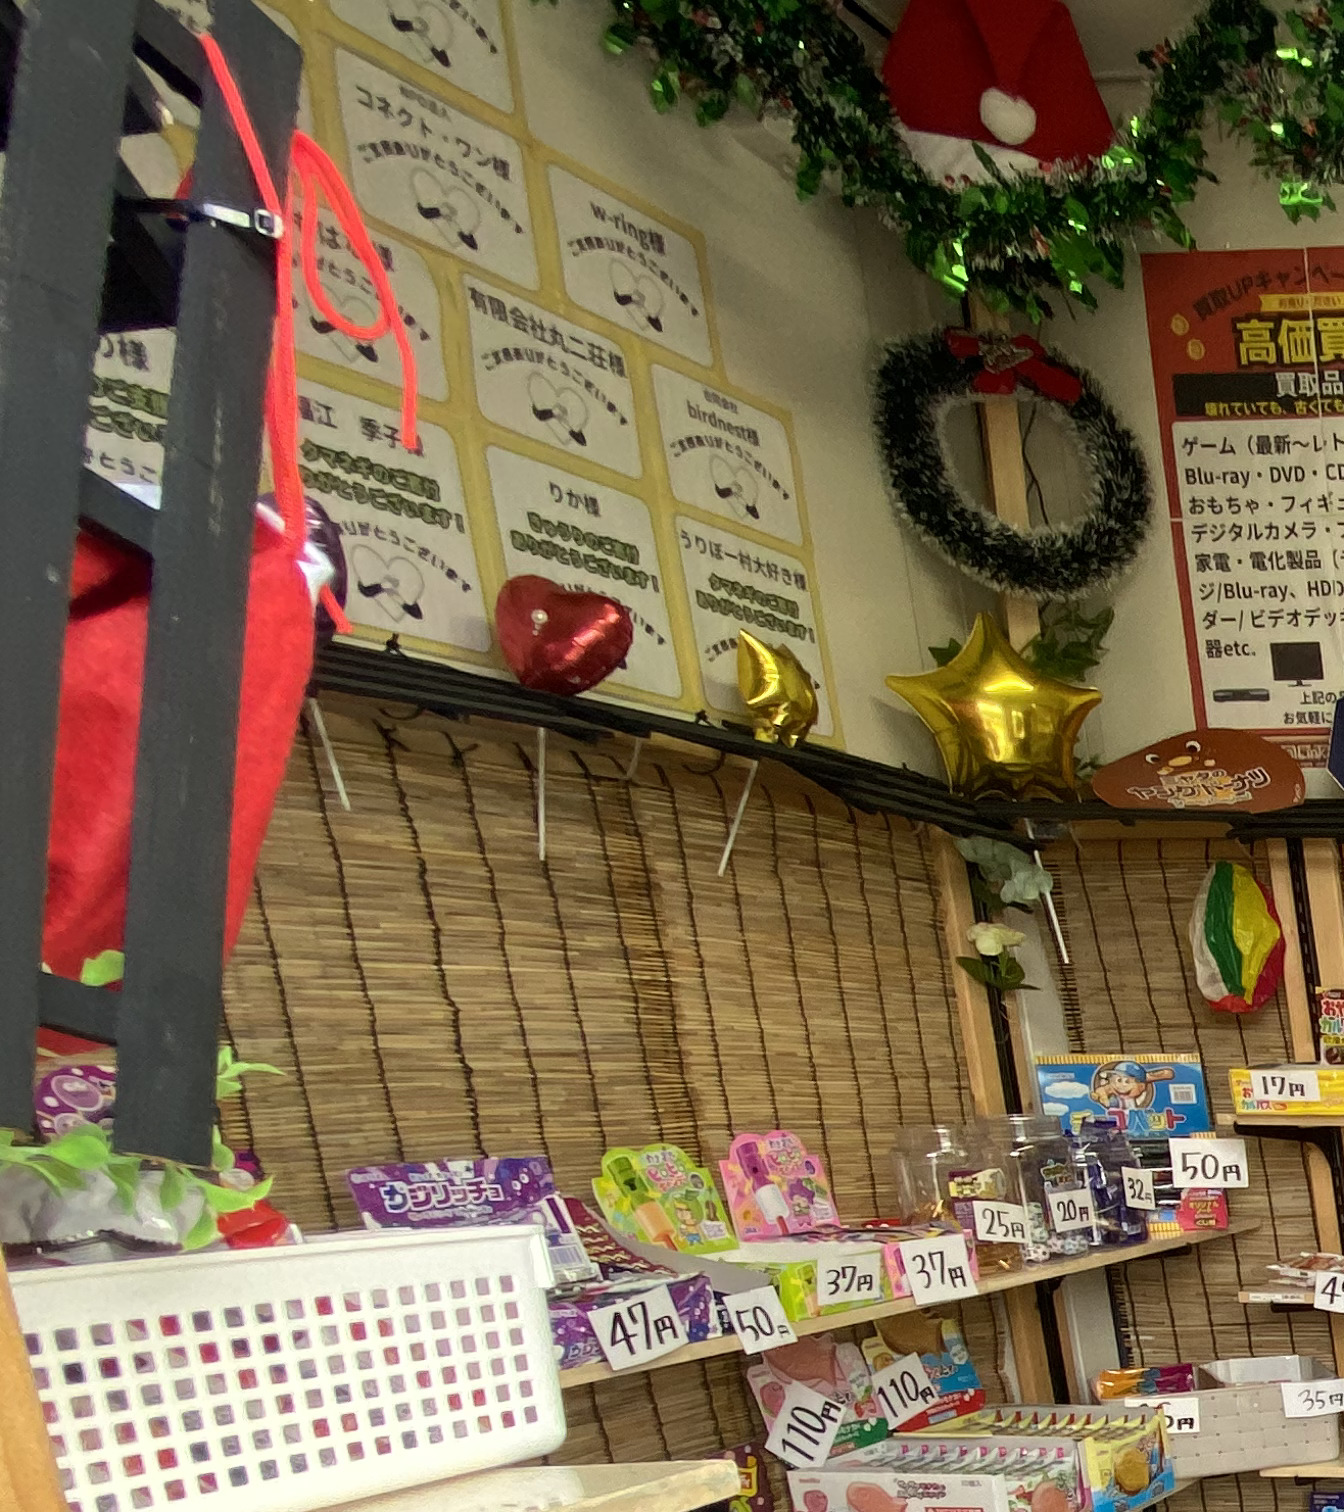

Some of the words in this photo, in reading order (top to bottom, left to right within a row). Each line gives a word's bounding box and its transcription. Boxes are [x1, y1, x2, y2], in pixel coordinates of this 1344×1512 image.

[590, 202, 666, 255] w-ring様
[686, 400, 760, 447] birdnest様
[1205, 639, 1257, 659] 器etc.
[1261, 1075, 1305, 1098] 17円
[1180, 1151, 1242, 1183] 50円
[1127, 1177, 1153, 1203] 32円
[982, 1208, 1025, 1239] 25円
[1056, 1199, 1090, 1224] 20円
[826, 1264, 874, 1296] 37円
[911, 1250, 968, 1289] 37円
[610, 1300, 681, 1357] 47円
[735, 1305, 790, 1343] 50円
[876, 1370, 936, 1418] 110円
[1300, 1389, 1344, 1412] 35円
[781, 1400, 843, 1462] 110円
